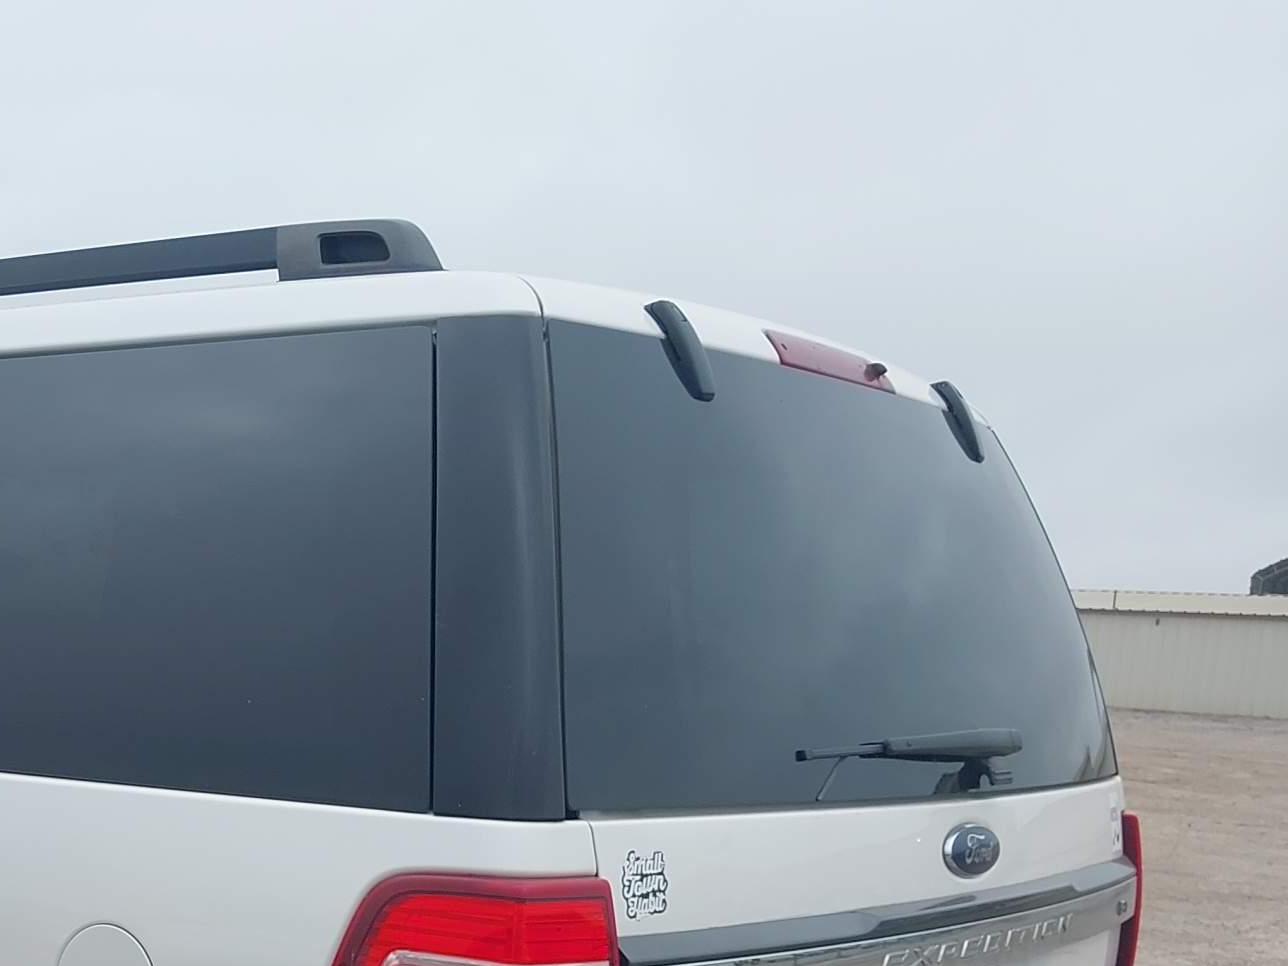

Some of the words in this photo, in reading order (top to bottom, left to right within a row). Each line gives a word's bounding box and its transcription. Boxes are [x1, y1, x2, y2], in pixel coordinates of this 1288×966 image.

[624, 849, 665, 875] Small
[964, 833, 995, 866] Ford
[622, 872, 668, 899] Town
[626, 890, 667, 919] Habit
